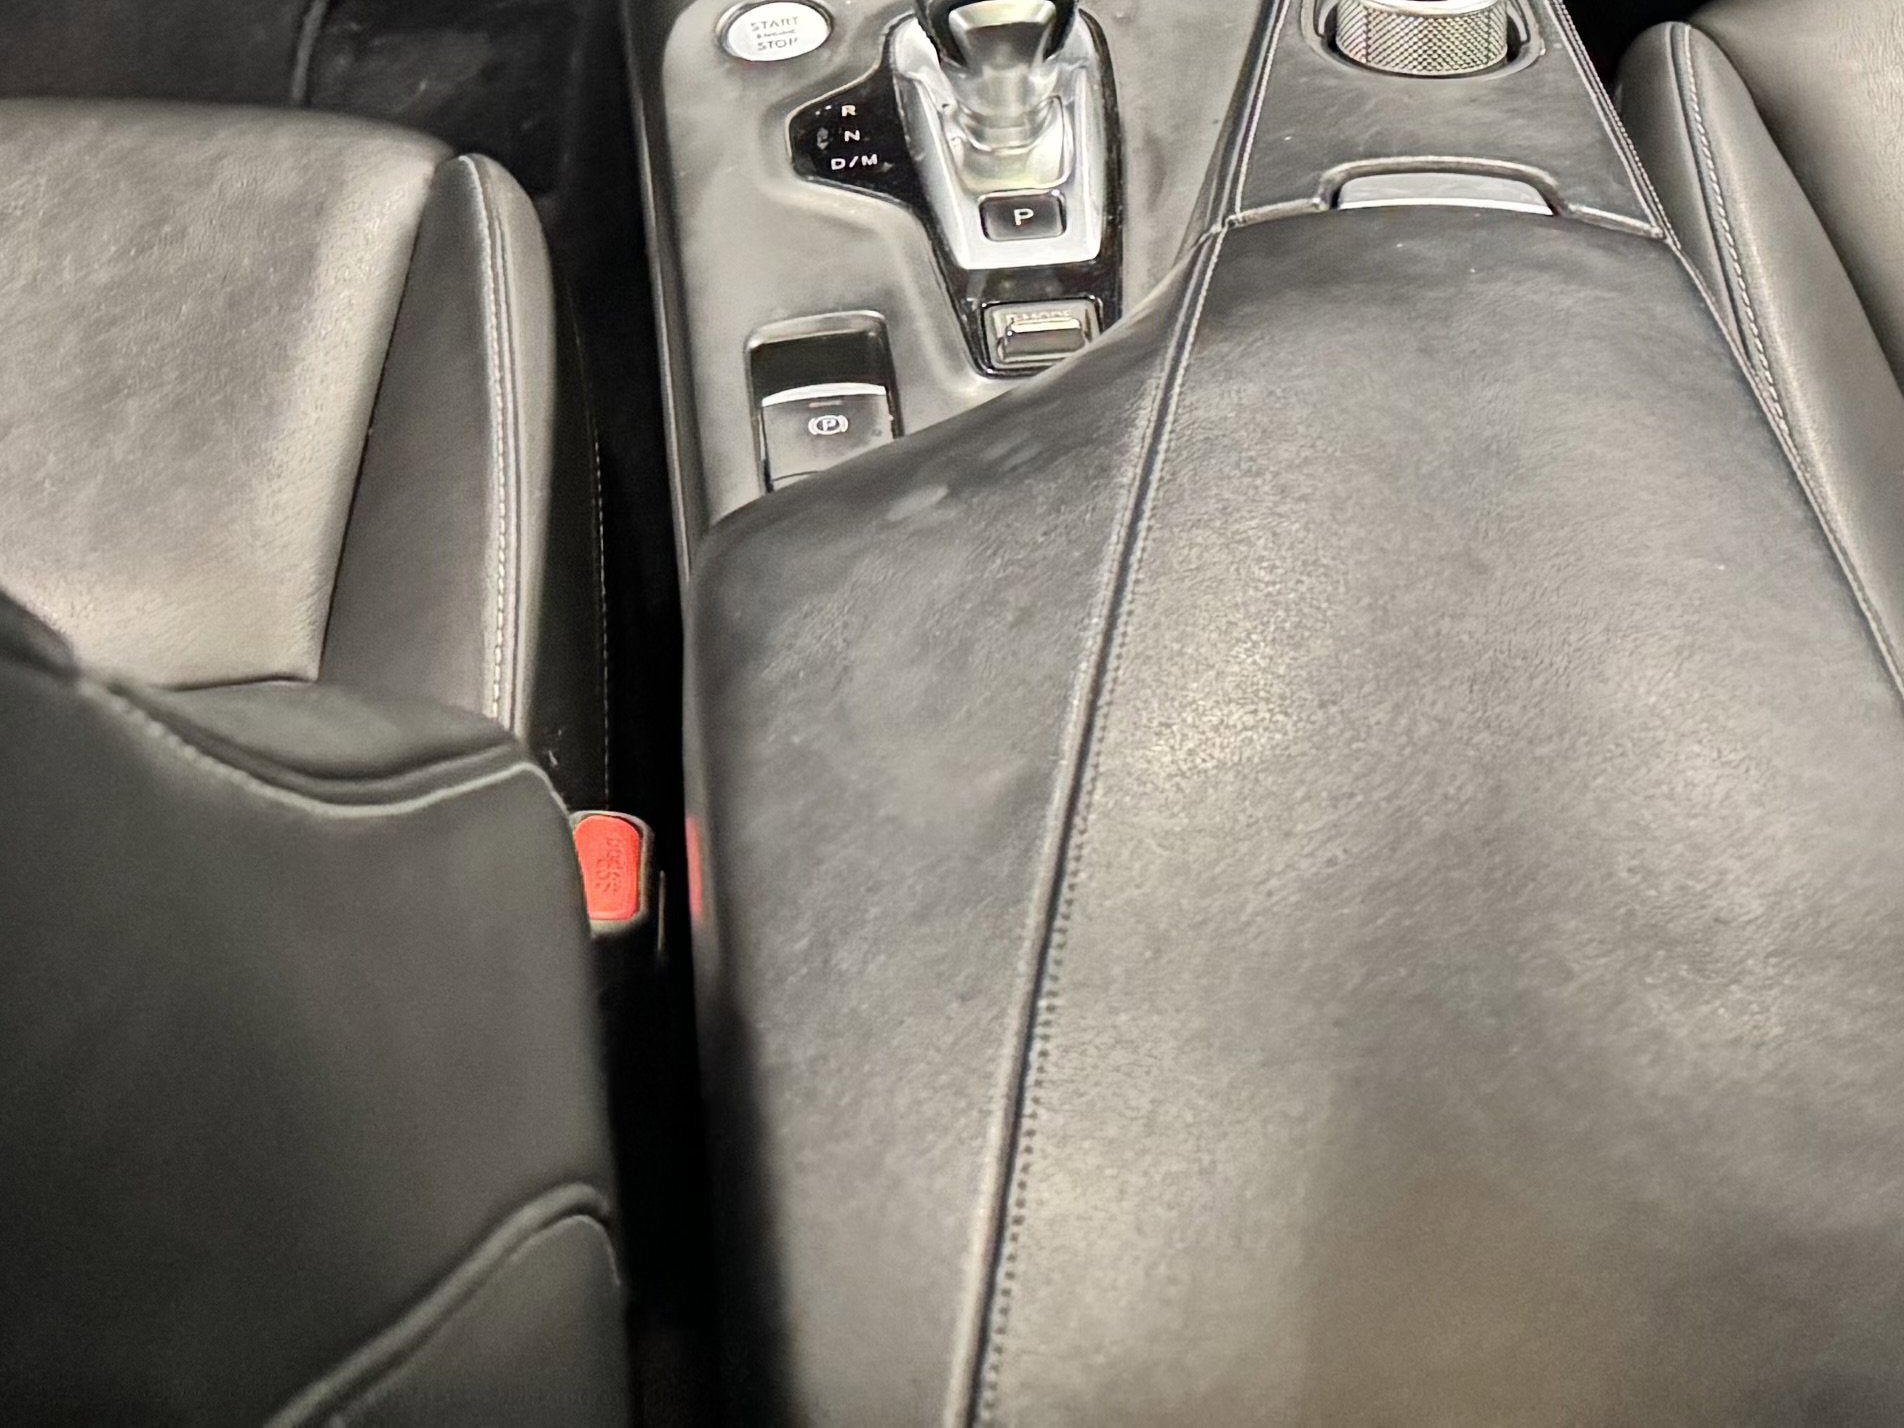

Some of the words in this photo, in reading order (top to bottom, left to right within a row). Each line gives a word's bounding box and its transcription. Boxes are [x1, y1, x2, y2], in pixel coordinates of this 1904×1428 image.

[750, 16, 799, 32] START
[757, 37, 798, 52] STOP
[841, 105, 856, 117] R
[844, 130, 860, 142] N
[830, 153, 878, 171] D/M
[1013, 208, 1034, 226] P
